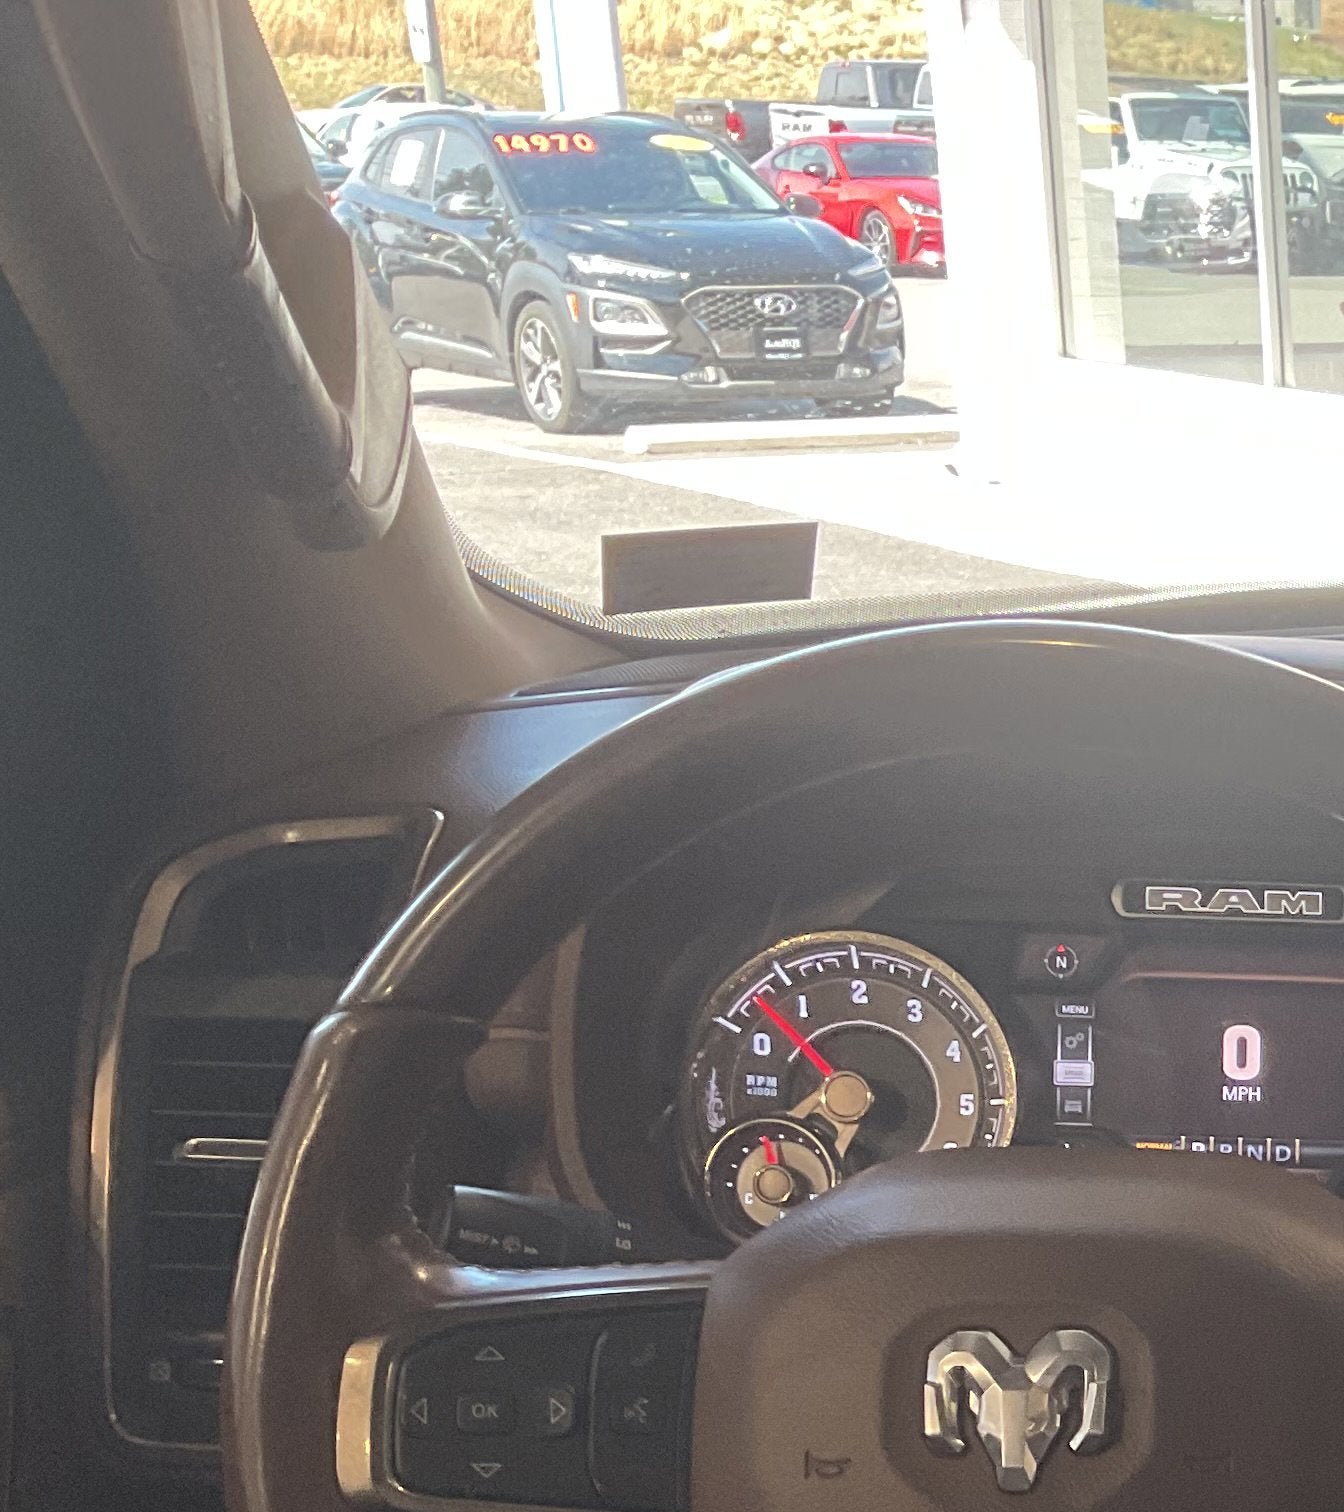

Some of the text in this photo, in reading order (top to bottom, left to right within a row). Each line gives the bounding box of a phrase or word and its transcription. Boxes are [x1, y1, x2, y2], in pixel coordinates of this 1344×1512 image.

[1145, 886, 1323, 915] RAM
[1056, 956, 1067, 969] N
[851, 980, 869, 1004] 2
[798, 995, 809, 1018] 1
[907, 999, 923, 1023] 3
[1062, 1004, 1089, 1014] MENU
[752, 1033, 771, 1056] 0
[946, 1040, 961, 1062] 4
[1222, 1024, 1262, 1081] 0
[960, 1094, 975, 1116] 5
[1222, 1086, 1262, 1102] MPH
[1247, 1144, 1263, 1161] N
[1275, 1145, 1292, 1162] D
[471, 1402, 498, 1419] OK
